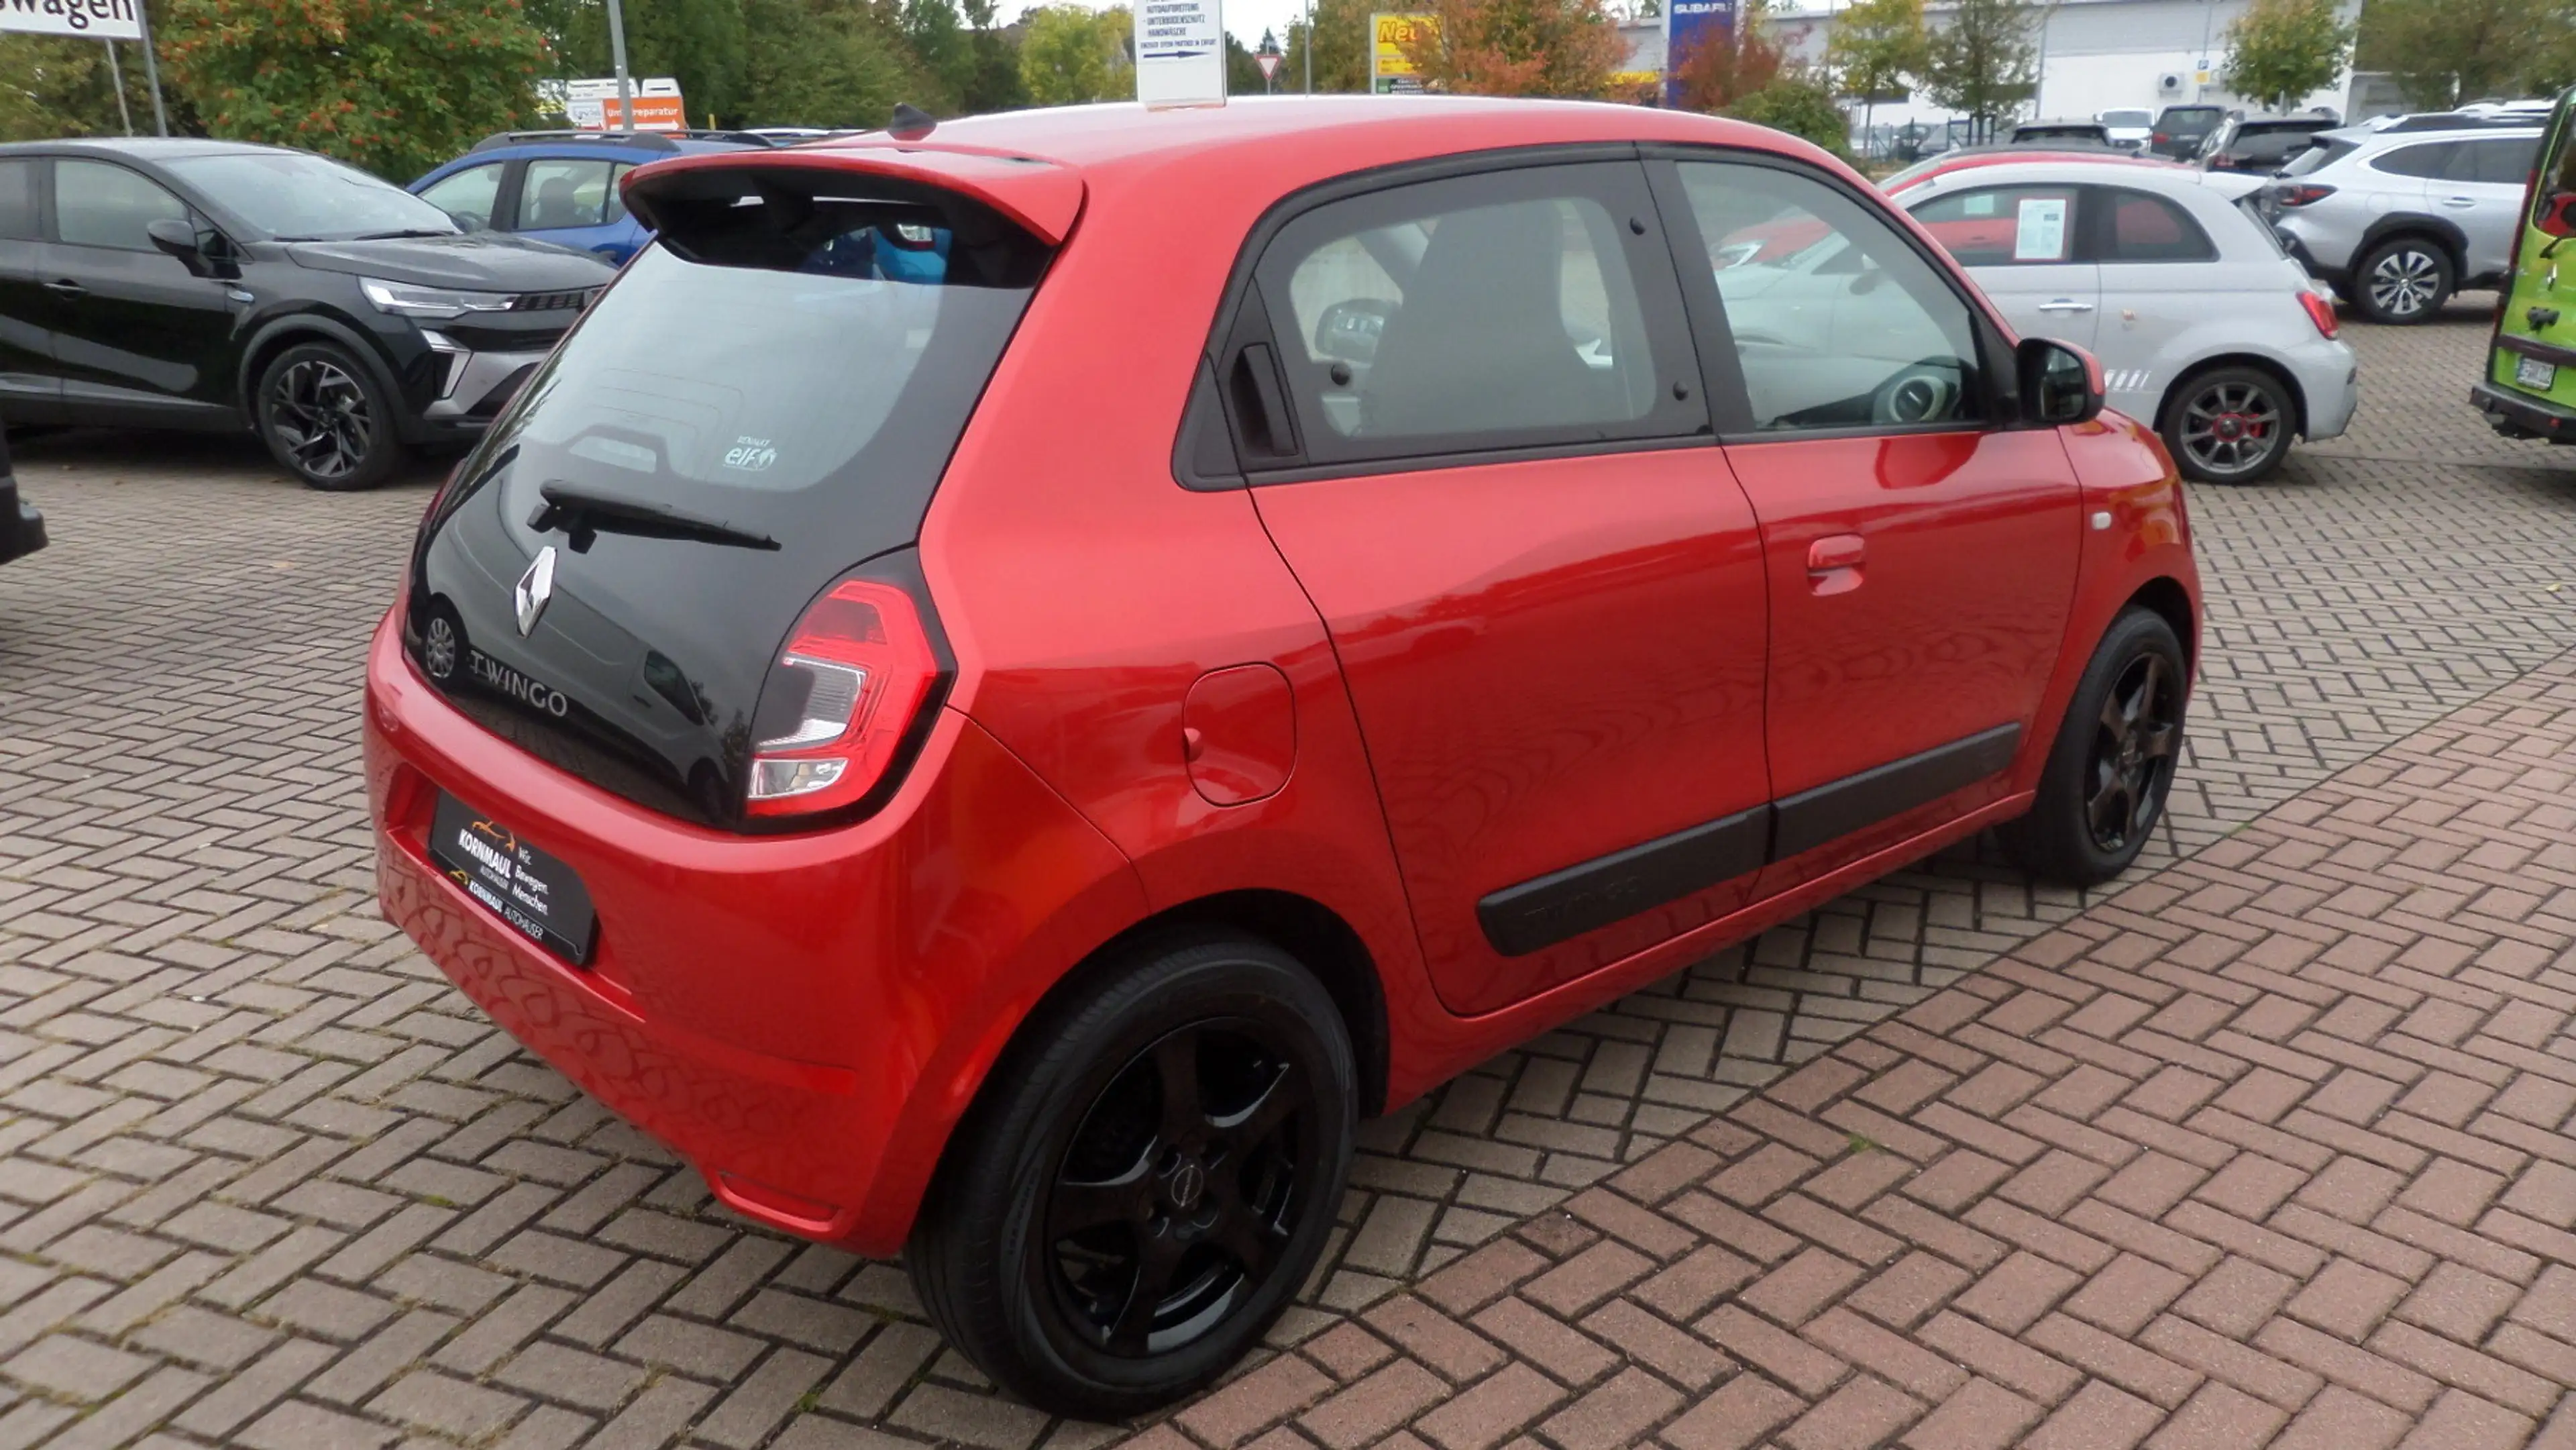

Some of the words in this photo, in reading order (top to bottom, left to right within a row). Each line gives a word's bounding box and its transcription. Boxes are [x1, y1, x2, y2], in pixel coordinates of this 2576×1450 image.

[0, 0, 135, 30] wagen
[470, 649, 568, 717] TWINGO
[458, 828, 513, 879] KORNMAUL
[469, 879, 504, 913] KORNMAUL
